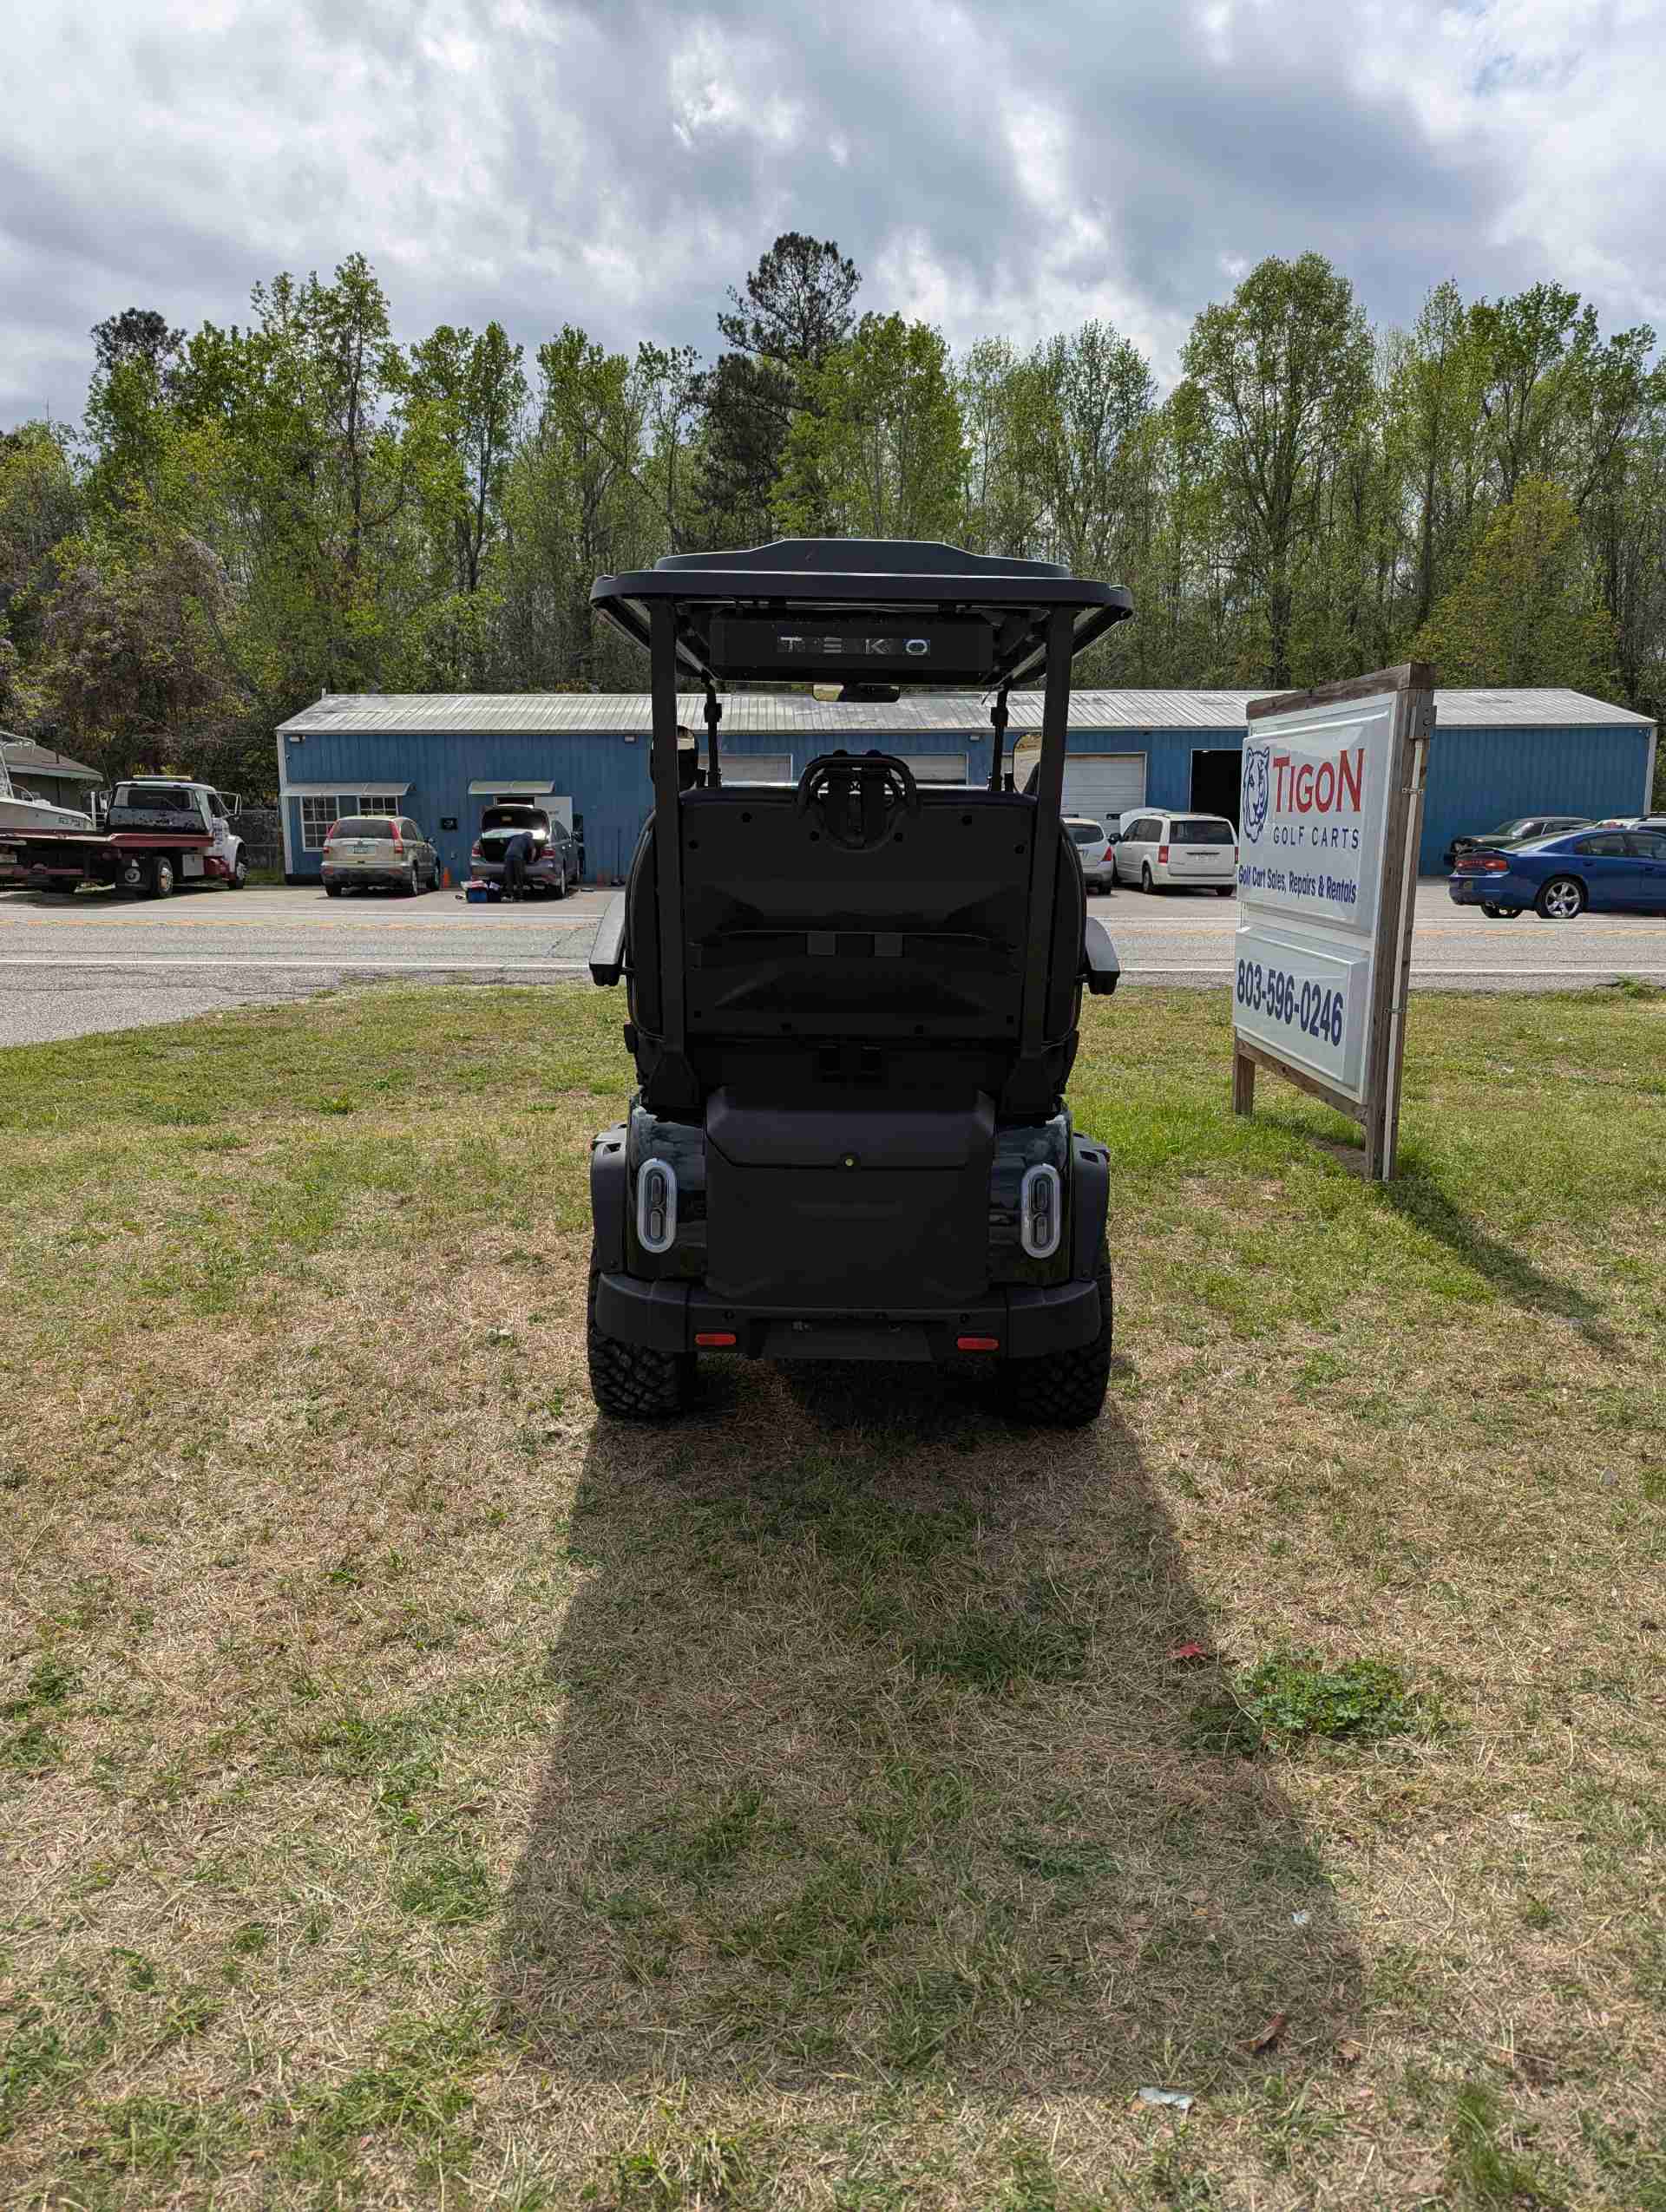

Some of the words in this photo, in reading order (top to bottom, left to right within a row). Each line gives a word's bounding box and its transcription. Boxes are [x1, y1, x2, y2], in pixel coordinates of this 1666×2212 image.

[780, 637, 928, 655] TEKO
[1273, 749, 1364, 813] TIGON
[1273, 826, 1305, 846] GOLF
[1311, 827, 1360, 849] CARTS
[1238, 865, 1251, 885] Golf
[1252, 866, 1266, 888] Cart
[1267, 867, 1287, 893] Sales,
[1289, 871, 1316, 899] Repairs
[1317, 874, 1325, 897] &
[1326, 875, 1357, 904] Rentals
[1236, 959, 1344, 1047] 803-596-0246
